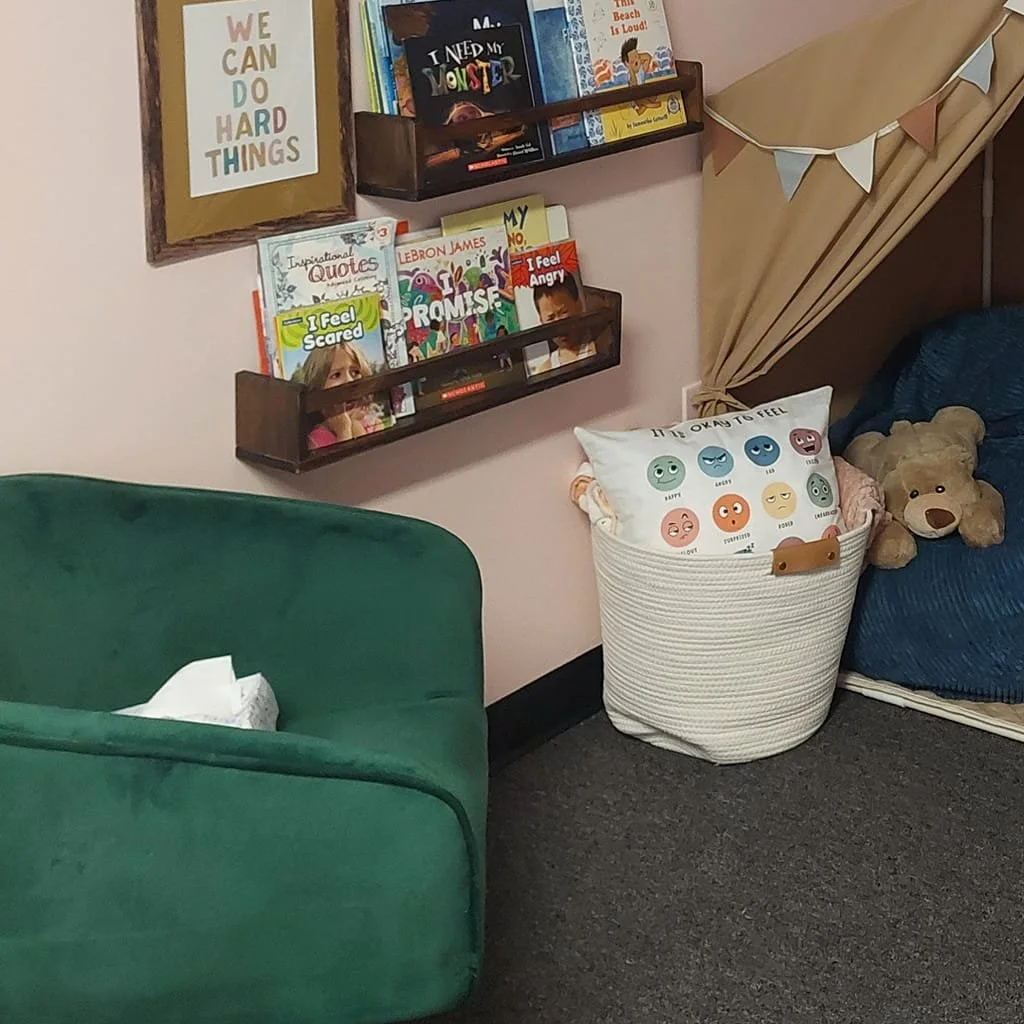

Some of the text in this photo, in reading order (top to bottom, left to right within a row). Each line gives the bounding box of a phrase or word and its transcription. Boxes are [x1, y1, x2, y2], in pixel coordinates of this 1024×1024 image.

[227, 11, 271, 43] WE
[612, 9, 641, 21] Beach
[610, 21, 648, 36] Is Loud!
[222, 43, 277, 76] CAN
[428, 39, 504, 65] I NEED MY
[422, 56, 522, 97] MONSTER
[232, 77, 269, 108] DO
[216, 106, 287, 144] HARD
[204, 135, 300, 178] THINGS
[503, 205, 528, 229] MY
[287, 245, 354, 271] Inspirational
[449, 236, 486, 255] JAMES
[308, 257, 379, 283] Quotes
[526, 250, 561, 272] I Feel
[440, 272, 453, 295] I
[529, 268, 565, 288] Angry
[307, 314, 318, 332] I
[320, 306, 356, 329] Feel
[402, 286, 502, 328] PROMISE
[303, 322, 364, 351] Scared
[651, 428, 665, 438] IT
[690, 419, 731, 432] OKAY
[733, 416, 753, 424] TO
[757, 407, 788, 418] FEEL
[715, 479, 732, 487] ANGRY
[765, 468, 775, 476] SAD
[664, 493, 681, 501] HAPPY
[724, 532, 751, 544] SURPRISED
